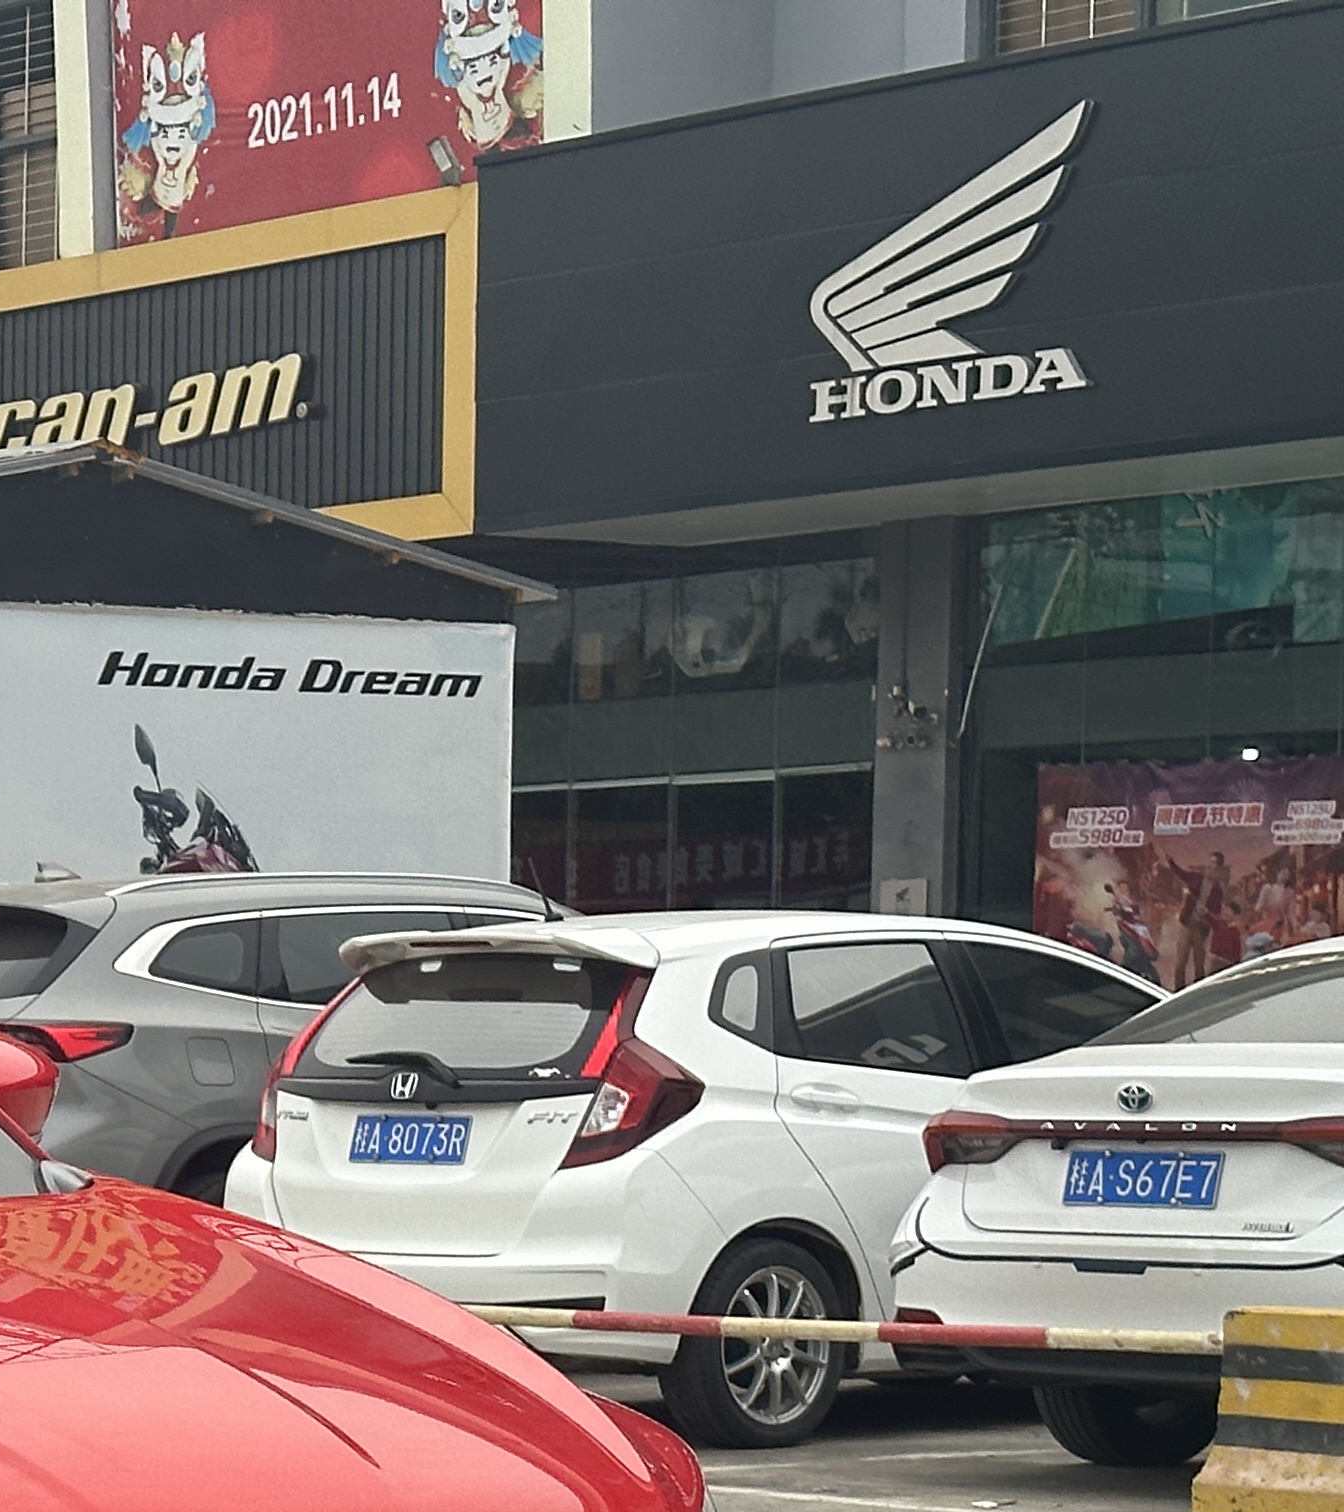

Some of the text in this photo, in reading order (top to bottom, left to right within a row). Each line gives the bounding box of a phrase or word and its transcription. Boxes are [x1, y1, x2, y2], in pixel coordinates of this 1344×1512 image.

[247, 73, 402, 149] 2021.11.14
[809, 347, 1093, 423] HONDA
[98, 651, 482, 698] Honda Dream
[1039, 1121, 1237, 1132] AVALON
